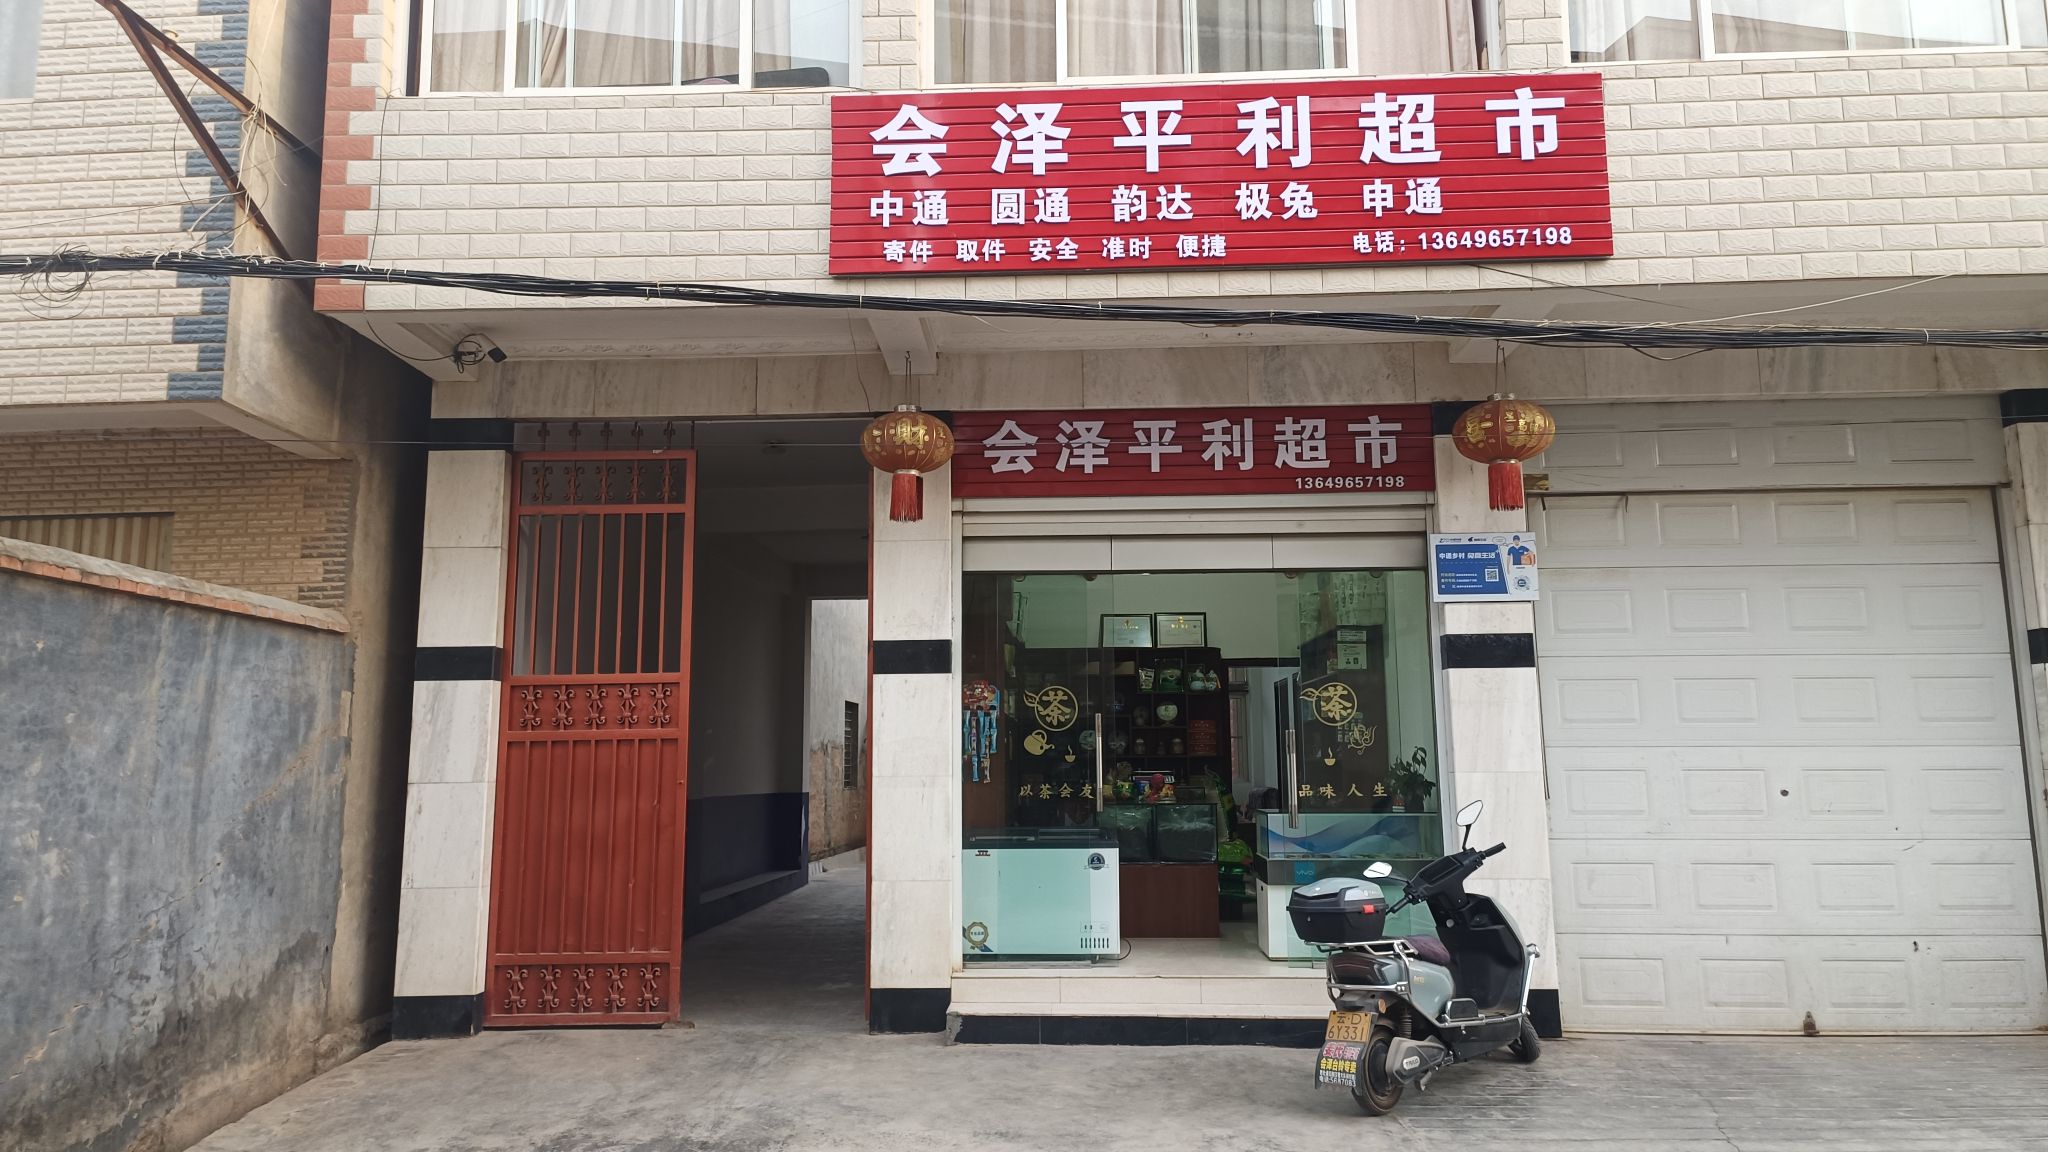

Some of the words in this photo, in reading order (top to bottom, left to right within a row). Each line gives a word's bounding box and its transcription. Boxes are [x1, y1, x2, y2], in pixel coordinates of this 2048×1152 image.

[869, 87, 1566, 176] 会泽平利超市
[870, 190, 949, 227] 中通
[990, 187, 1071, 225] 圆通
[1111, 184, 1194, 222] 韵达
[1234, 181, 1318, 220] 极兔
[1361, 177, 1445, 218] 申通
[883, 239, 933, 263] 寄件
[956, 238, 1005, 262] 取件
[1028, 237, 1079, 261] 安全
[1101, 236, 1153, 260] 准时
[1175, 233, 1227, 258] 便捷
[982, 414, 1402, 474] 会泽平利超市
[1295, 475, 1405, 489] 13649657198
[1039, 690, 1072, 726] 茶
[1320, 685, 1353, 721] 茶
[1019, 783, 1095, 799] 以茶会友
[1298, 783, 1388, 799] 品味人生
[1327, 1025, 1365, 1041] 6Y331
